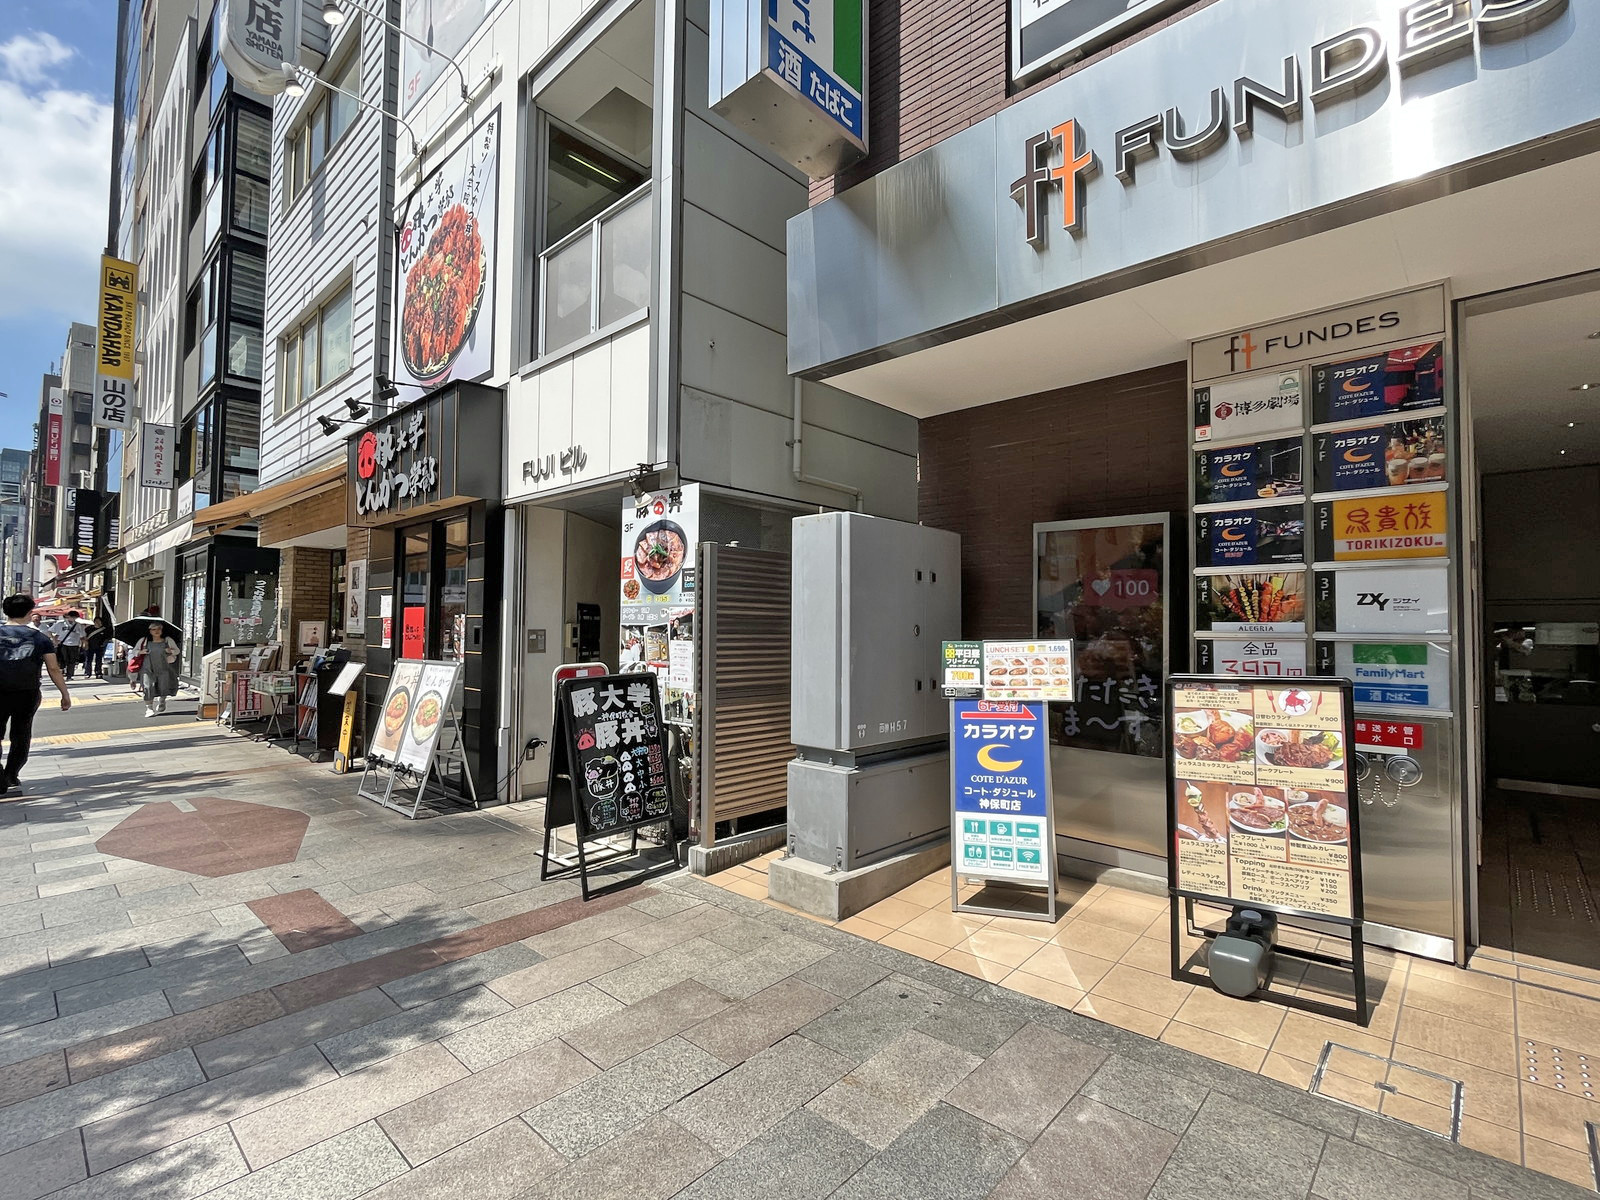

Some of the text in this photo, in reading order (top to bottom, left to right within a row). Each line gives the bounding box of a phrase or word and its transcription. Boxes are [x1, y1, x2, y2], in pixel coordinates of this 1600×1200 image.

[246, 28, 283, 53] YAMADA
[245, 38, 283, 61] SHOTEN
[778, 39, 853, 128] 酒 たばこ
[101, 293, 124, 368] KANDAHAR
[1266, 311, 1400, 353] FUNDES
[1333, 363, 1380, 379] カラオケ
[102, 379, 126, 423] 山の店
[1234, 393, 1300, 417] 博多劇場
[1334, 435, 1381, 449] カラオケ
[522, 444, 588, 484] FUJI ビル
[1213, 452, 1252, 464] カラオケ
[1214, 517, 1253, 527] カラオケ
[1345, 502, 1433, 535] 鳥貴族
[624, 523, 634, 533] 3F
[1346, 536, 1433, 551] TORIKIZOKU
[1115, 580, 1149, 595] 100
[1356, 593, 1390, 611] ZXY
[986, 646, 1008, 654] LUNCH
[1243, 642, 1278, 656] 全品
[1355, 667, 1425, 680] FamilyMart
[571, 683, 650, 718] 豚大学
[1369, 690, 1414, 701] 酒 たばこ
[595, 717, 646, 750] 豚丼
[964, 724, 1035, 740] カラオケ
[971, 775, 995, 783] COTE
[964, 786, 1037, 799] コート・ダジュール
[979, 798, 1022, 811] 神保町店
[1235, 857, 1266, 868] Topping
[1242, 884, 1264, 893] Drink
